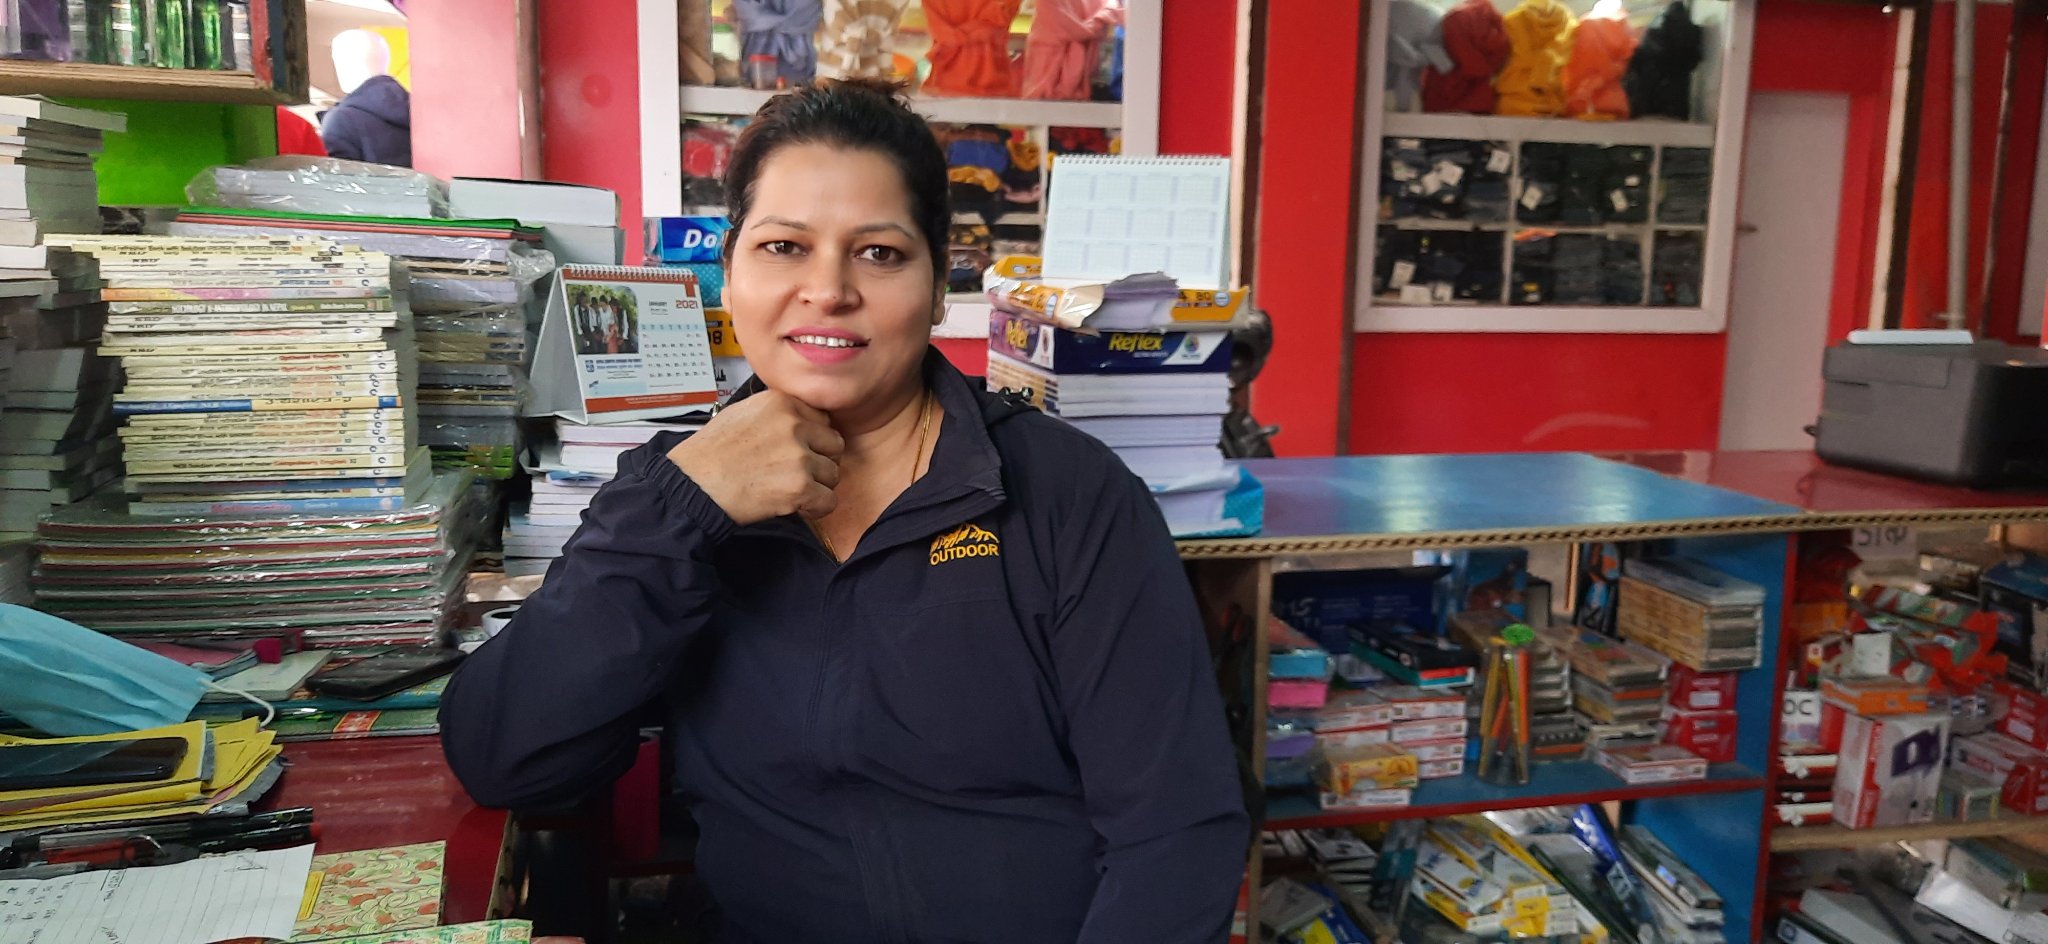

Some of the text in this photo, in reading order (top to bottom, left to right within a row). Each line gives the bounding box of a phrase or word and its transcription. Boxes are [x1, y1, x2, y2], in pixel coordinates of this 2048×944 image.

[676, 300, 699, 309] 2021
[1108, 333, 1164, 352] Reflex
[930, 543, 999, 566] OUTDOOR
